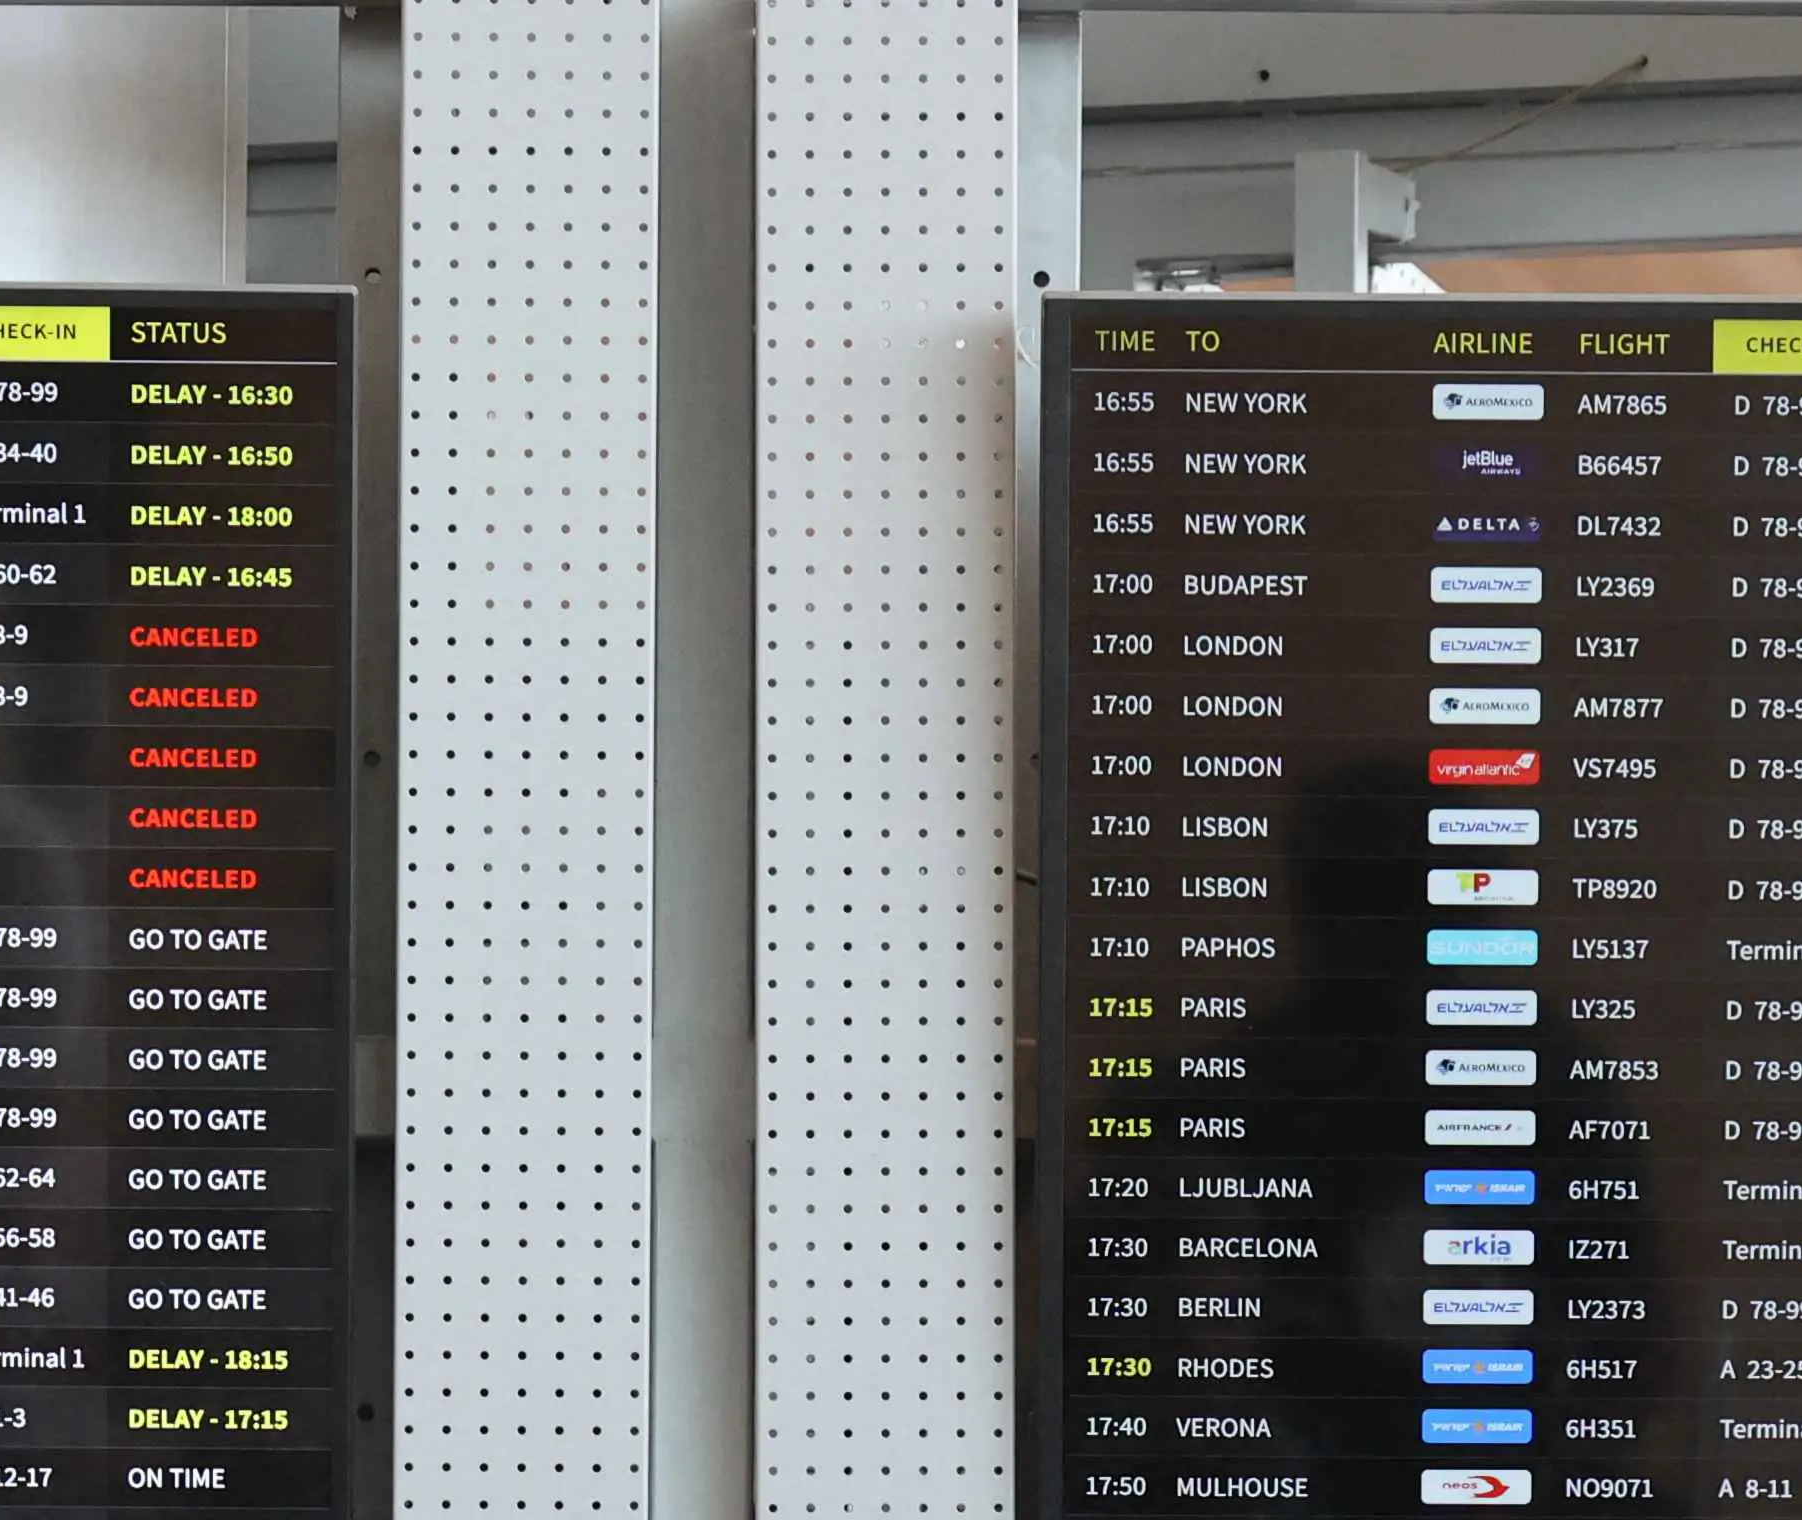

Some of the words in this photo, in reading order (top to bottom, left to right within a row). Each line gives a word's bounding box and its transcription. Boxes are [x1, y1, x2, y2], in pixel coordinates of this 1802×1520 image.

[131, 321, 227, 344] STATUS
[1094, 330, 1156, 352] TIME
[1185, 330, 1220, 352] TO
[1433, 332, 1533, 355] AIRLINE
[1580, 333, 1671, 355] FLIGHT
[1094, 391, 1155, 412] 16:55
[1186, 392, 1239, 413] NEW
[1244, 392, 1307, 414] YORK
[1577, 394, 1667, 416] AM7865
[1734, 395, 1751, 416] D
[131, 445, 207, 465] DELAY
[227, 446, 293, 467] 16:50
[1093, 513, 1154, 534] 16:55
[1185, 513, 1238, 535] NEW
[1242, 514, 1306, 536] YORK
[1457, 517, 1520, 532] DELTA
[1577, 515, 1662, 537] DL7432
[1733, 516, 1749, 537] D
[129, 626, 259, 648] CANCELED
[1091, 755, 1152, 776] 17:00
[1183, 756, 1282, 778] LONDON
[1437, 763, 1473, 779] virgin
[1475, 763, 1520, 777] atlantic
[1573, 757, 1657, 779] VS7495
[1730, 758, 1746, 779] D
[128, 807, 258, 830] CANCELED
[1090, 937, 1149, 958] 17:10
[1181, 937, 1276, 959] PAPHOS
[1572, 938, 1649, 960] LY5137
[128, 1048, 164, 1071] GO
[168, 1049, 202, 1071] TO
[207, 1049, 267, 1071] GATE
[1089, 1057, 1153, 1078] 17:15
[1180, 1057, 1246, 1079] PARIS
[1569, 1059, 1659, 1081] AM7853
[1725, 1060, 1742, 1081] D
[1088, 1237, 1148, 1258] 17:30
[1179, 1237, 1319, 1259] BARCELONA
[1448, 1233, 1512, 1256] arkia
[1568, 1239, 1630, 1260] IZ271
[128, 1408, 205, 1429] DELAY
[224, 1409, 289, 1431] 17:15
[1085, 1476, 1147, 1496] 17:50
[1177, 1477, 1309, 1498] MULHOUSE
[1441, 1482, 1478, 1490] neos
[1566, 1477, 1654, 1499] NO9071
[1717, 1478, 1735, 1498] A
[1745, 1479, 1793, 1499] 8-11
